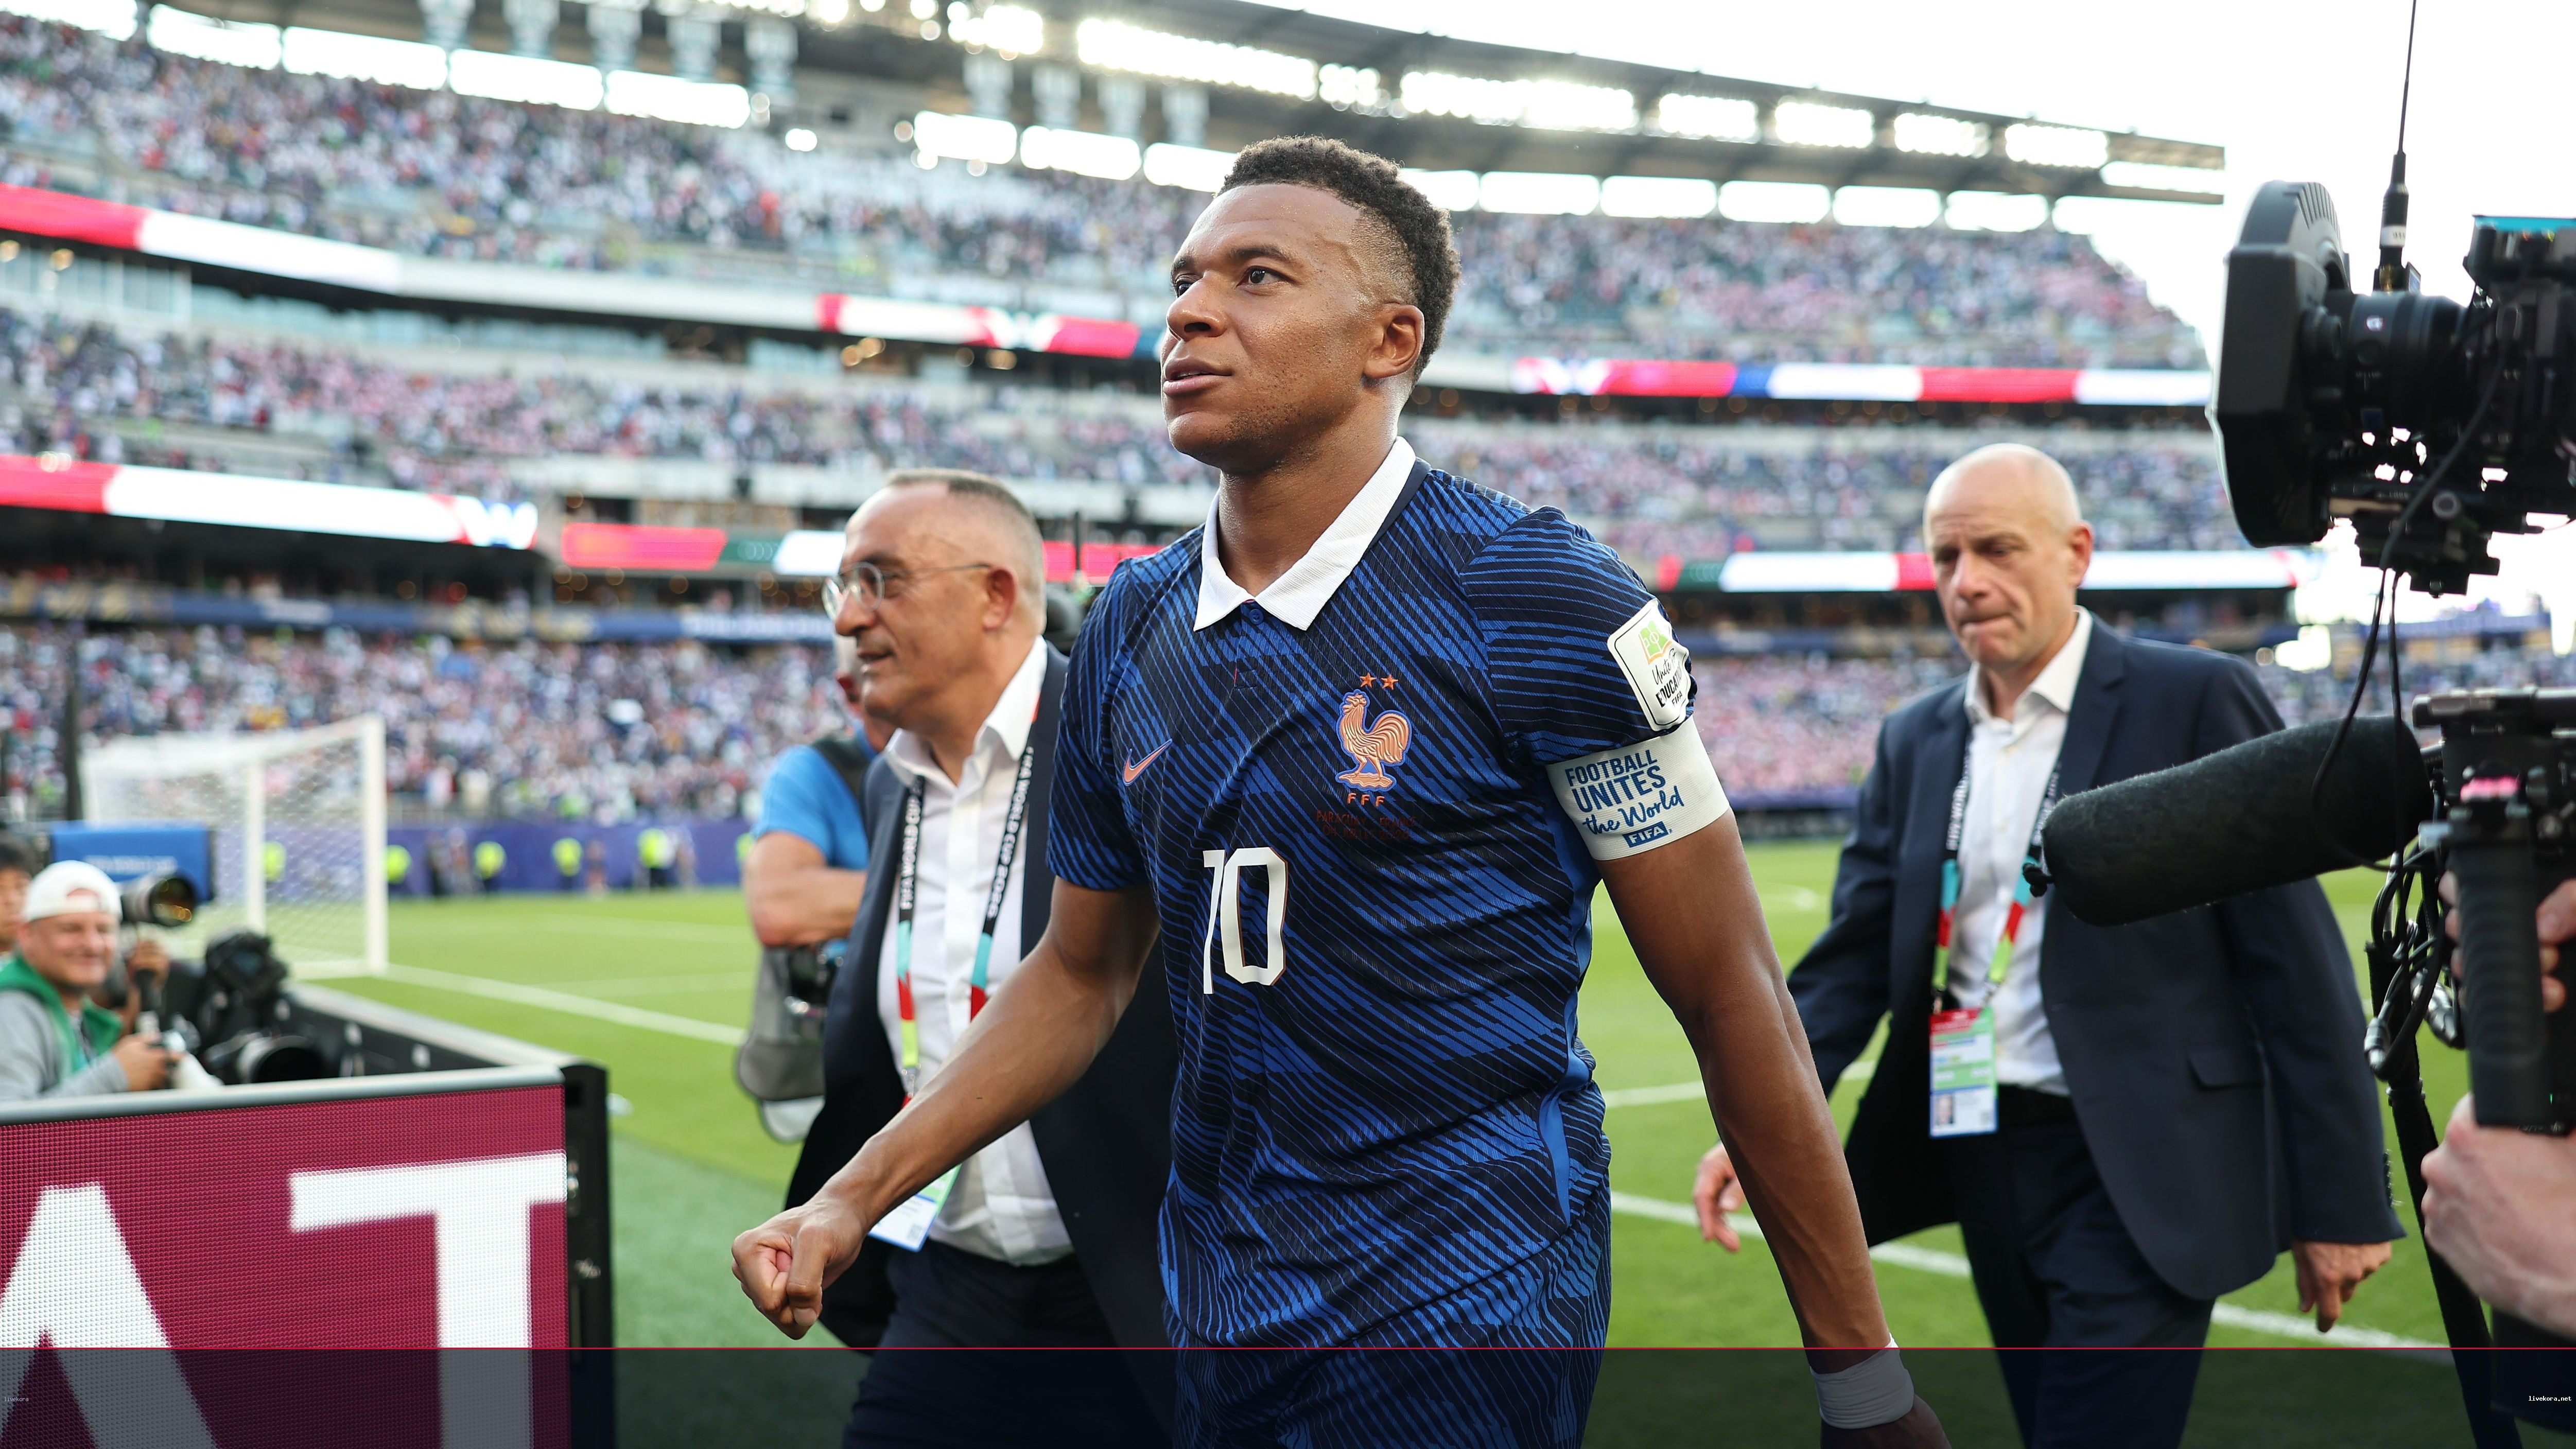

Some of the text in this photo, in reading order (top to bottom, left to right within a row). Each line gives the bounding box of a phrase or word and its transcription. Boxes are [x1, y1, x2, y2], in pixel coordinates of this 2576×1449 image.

[1564, 749, 1658, 787] FOOTBALL
[1572, 765, 1666, 813] UNITES
[1582, 785, 1685, 835] the World
[1628, 824, 1665, 844] FIFA
[1203, 847, 1289, 994] 10
